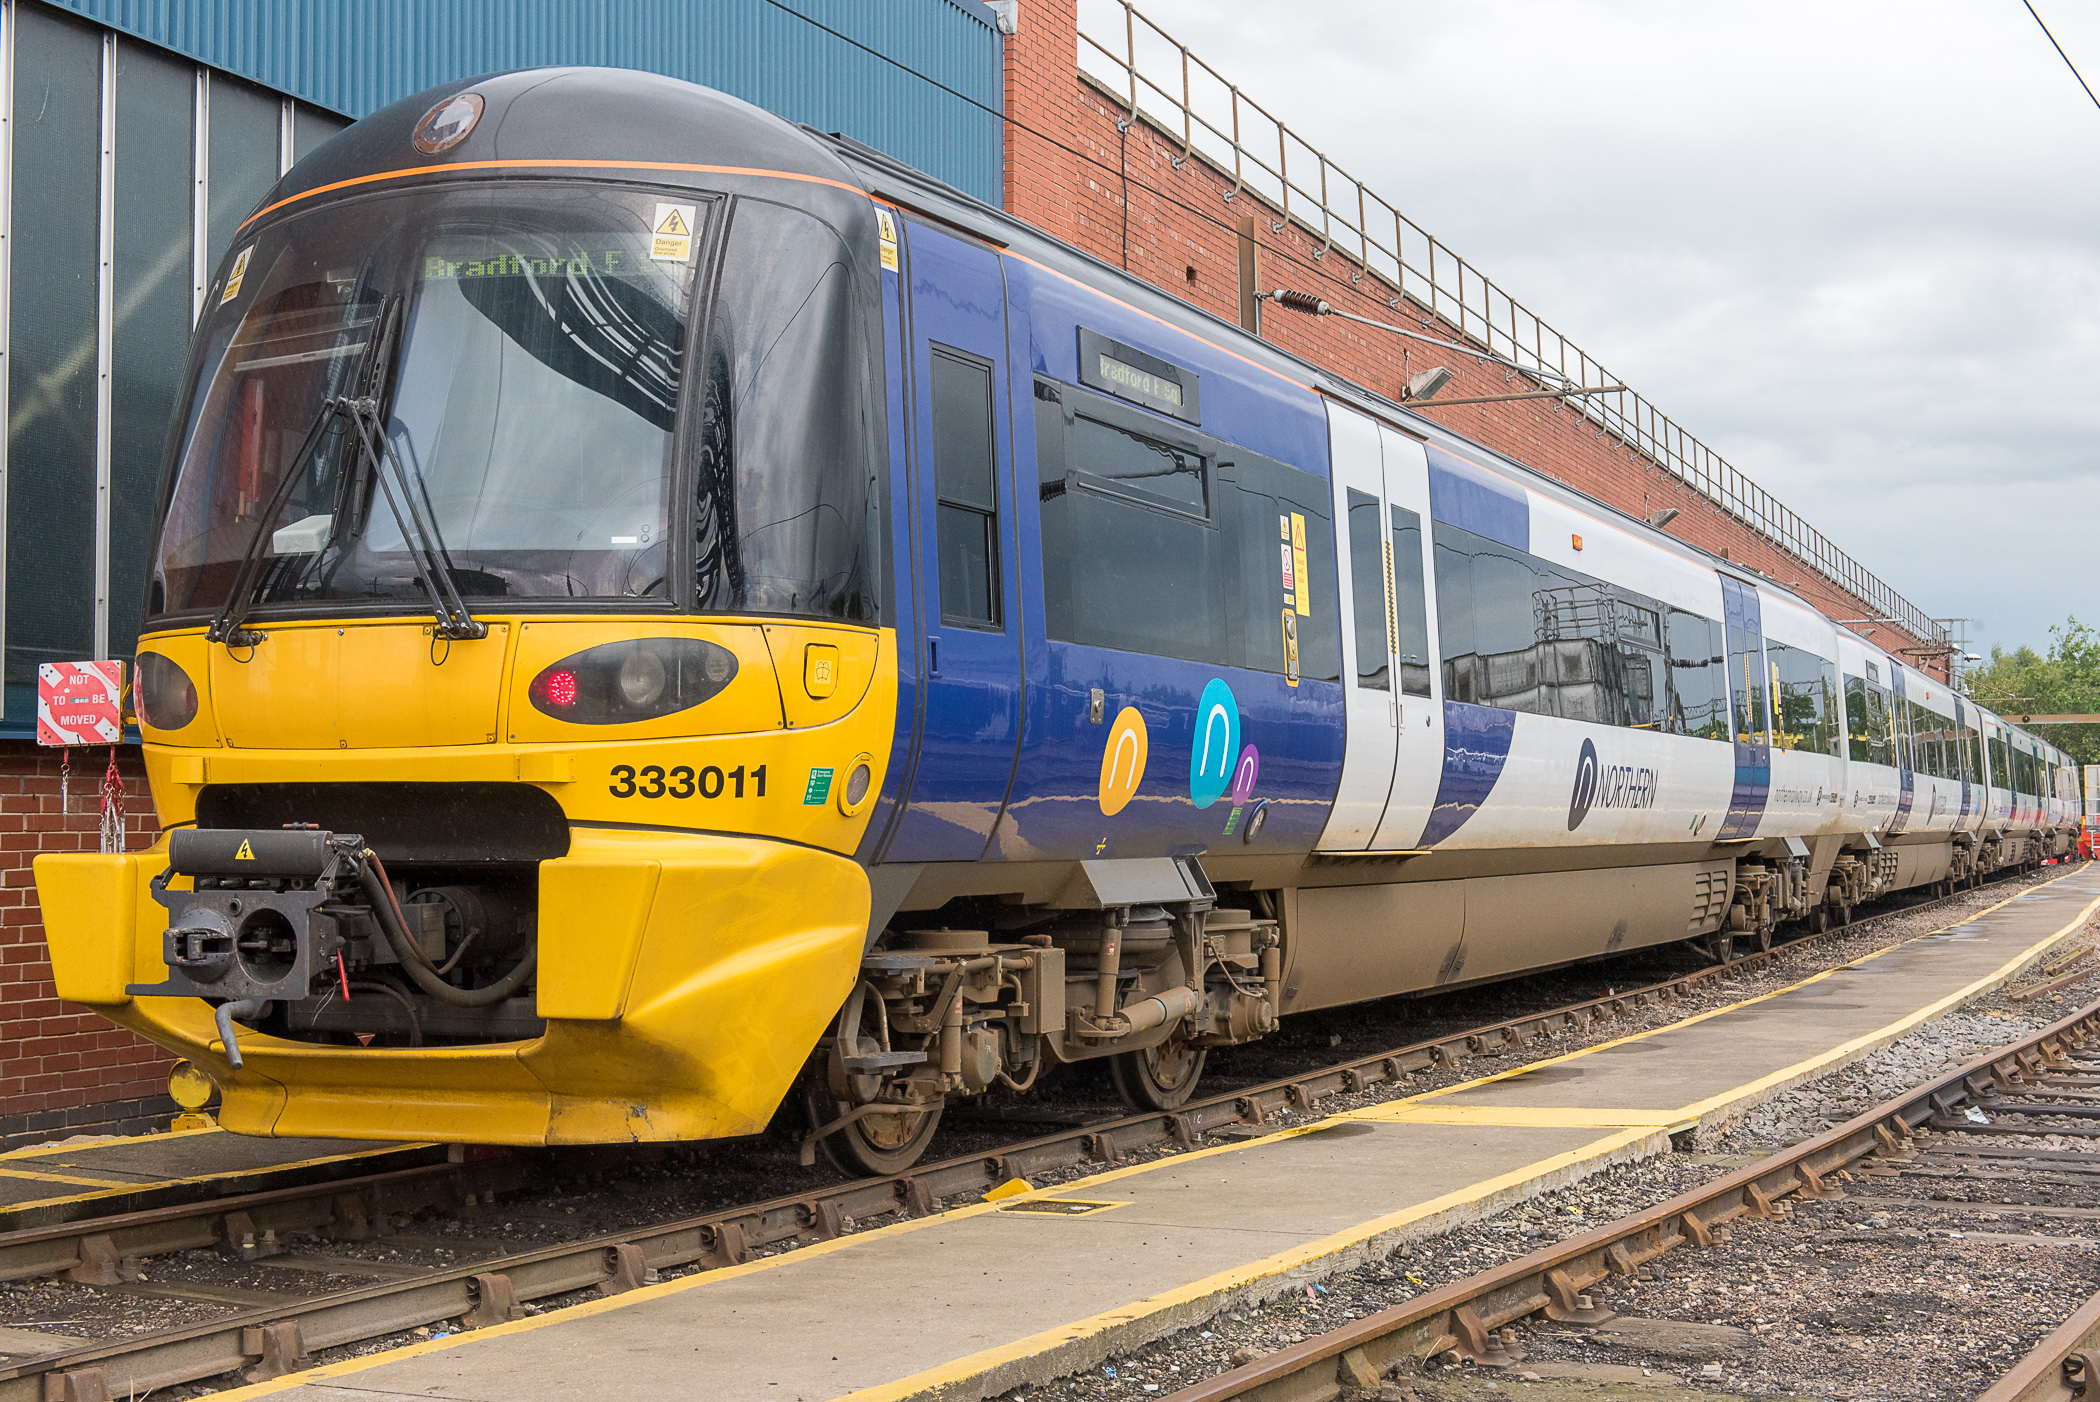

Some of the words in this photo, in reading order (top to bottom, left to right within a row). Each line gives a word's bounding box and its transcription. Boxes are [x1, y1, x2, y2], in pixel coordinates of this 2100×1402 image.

[655, 238, 682, 247] Danger
[424, 251, 589, 278] Bradford
[69, 674, 90, 685] NOT
[53, 695, 66, 706] TO
[92, 693, 105, 704] BE
[60, 714, 96, 726] MOVED
[608, 764, 767, 799] 333011
[1594, 763, 1659, 809] NORTHERN
